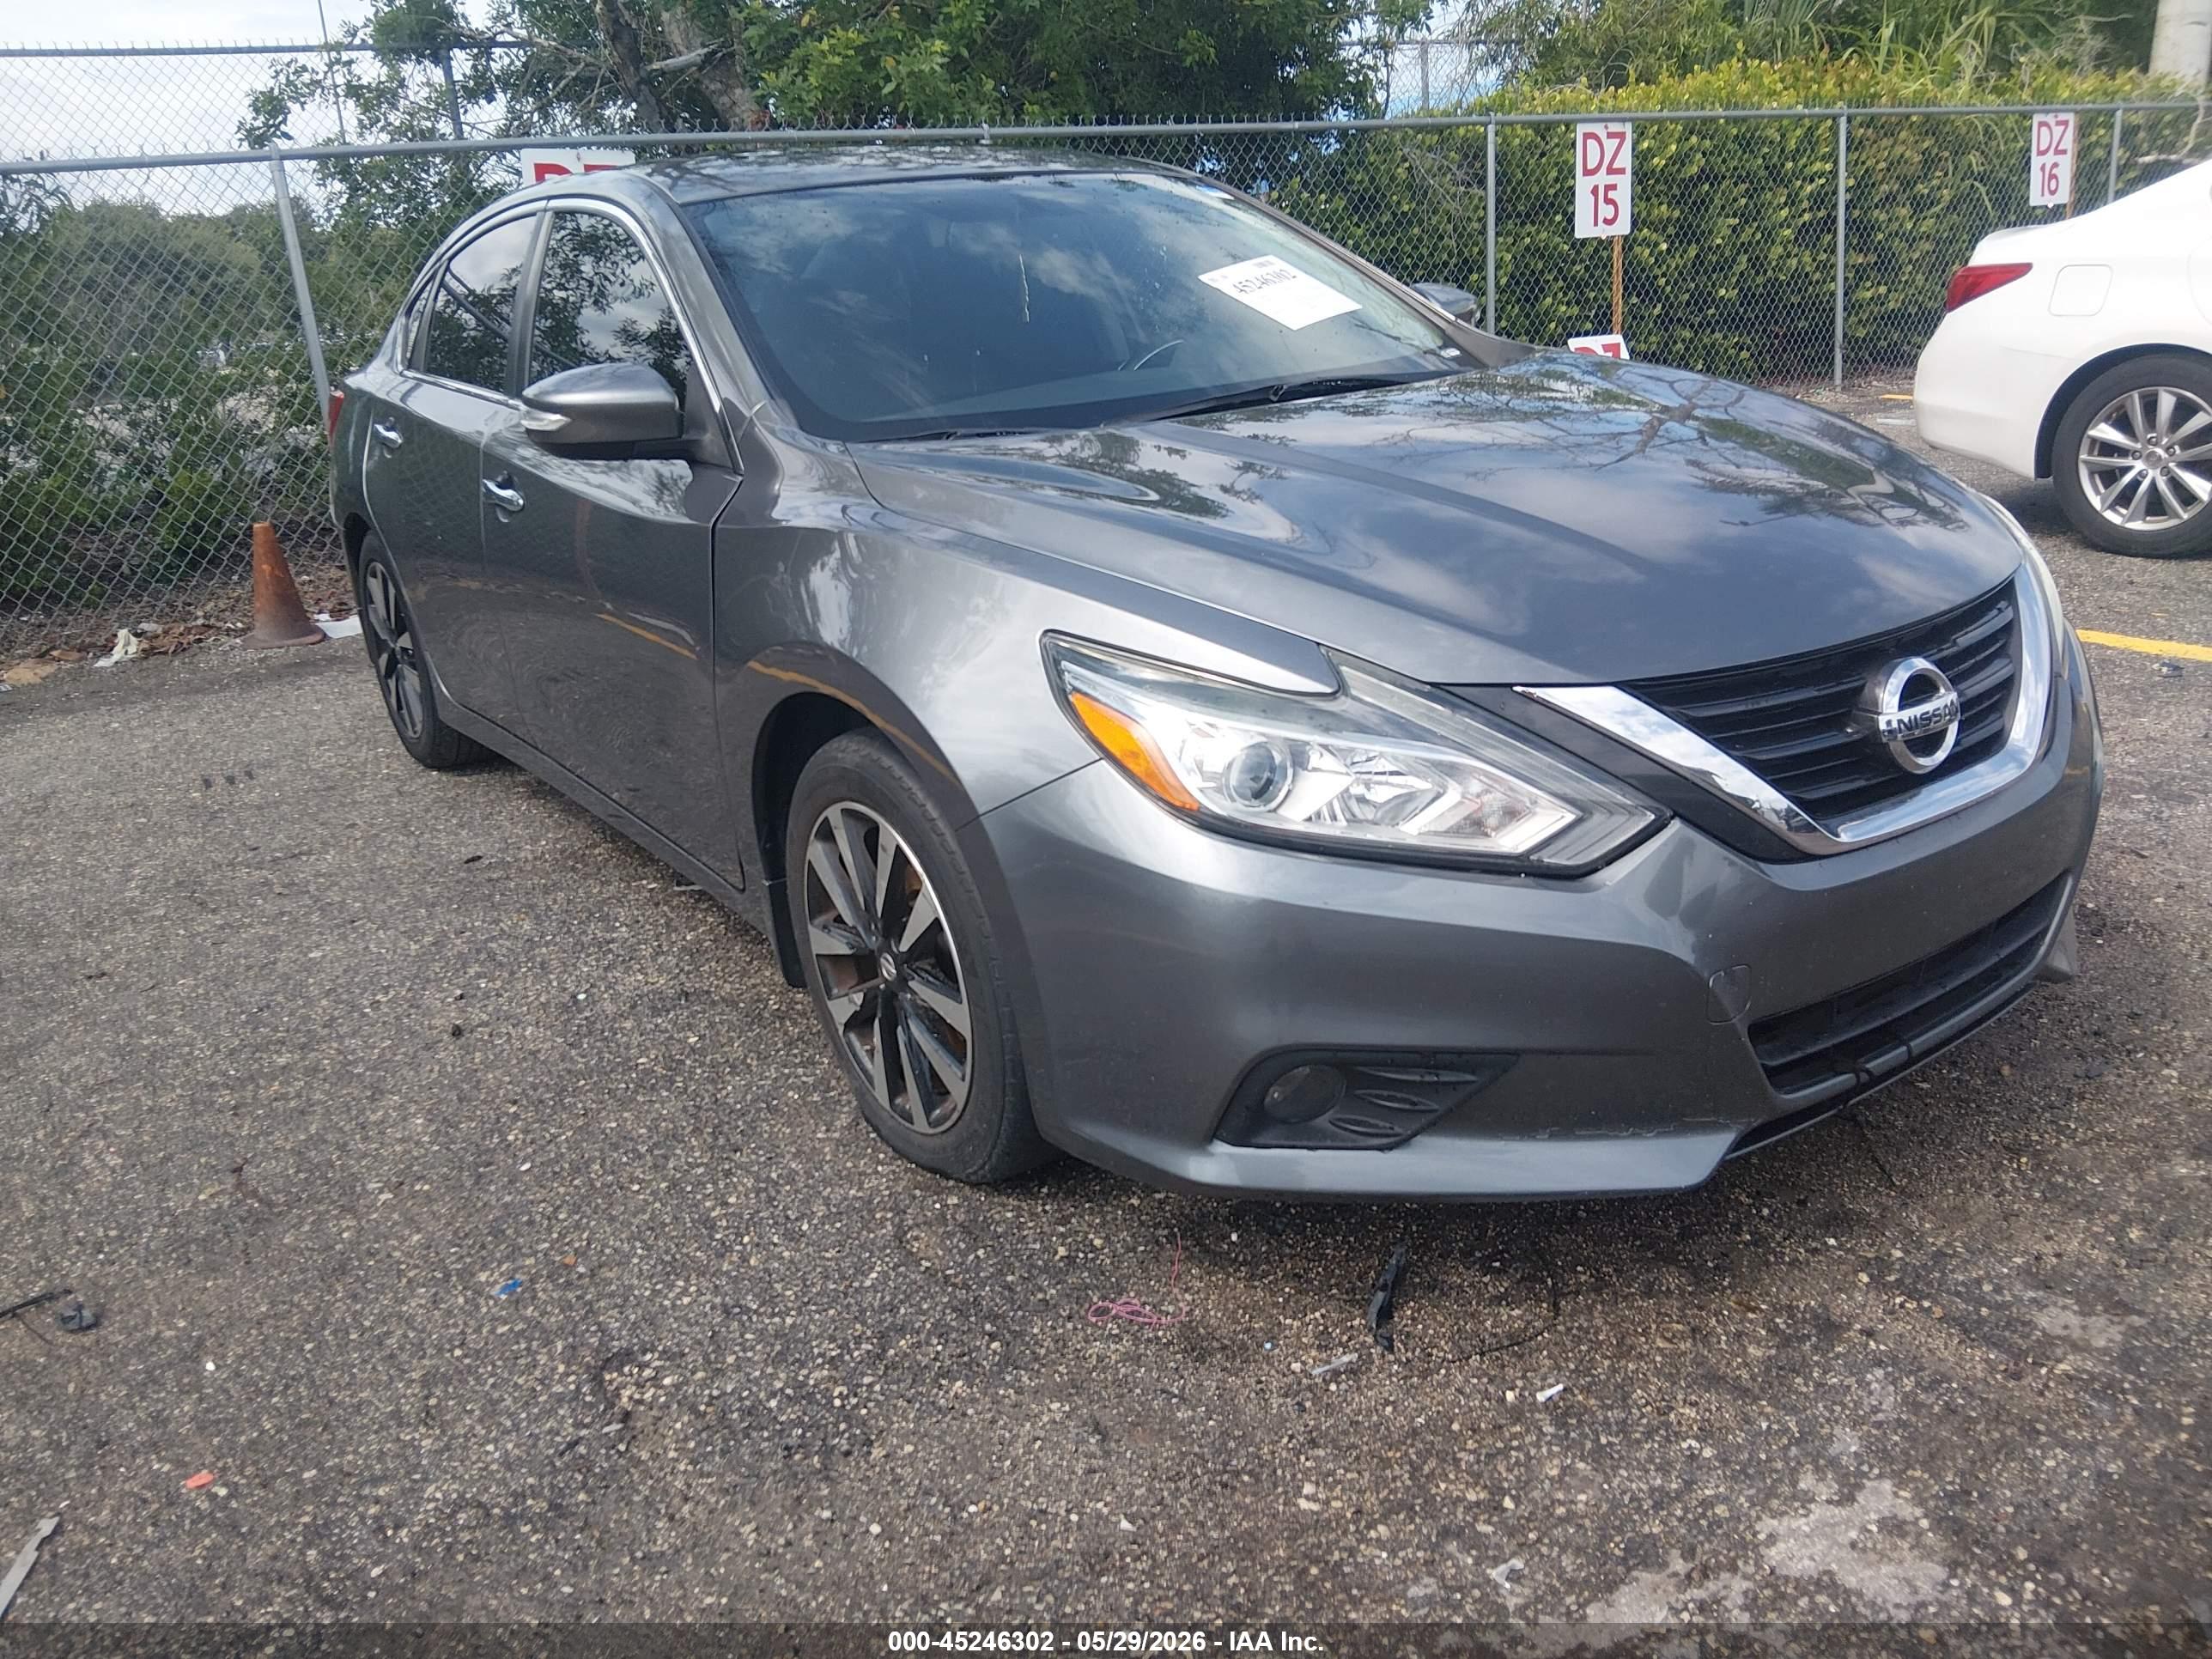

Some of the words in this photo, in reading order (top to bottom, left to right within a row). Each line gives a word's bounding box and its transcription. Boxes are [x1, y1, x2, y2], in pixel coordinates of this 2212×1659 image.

[1582, 131, 1627, 177] DZ
[2036, 119, 2069, 157] DZ
[2039, 161, 2060, 197] 16
[1589, 183, 1620, 227] 15
